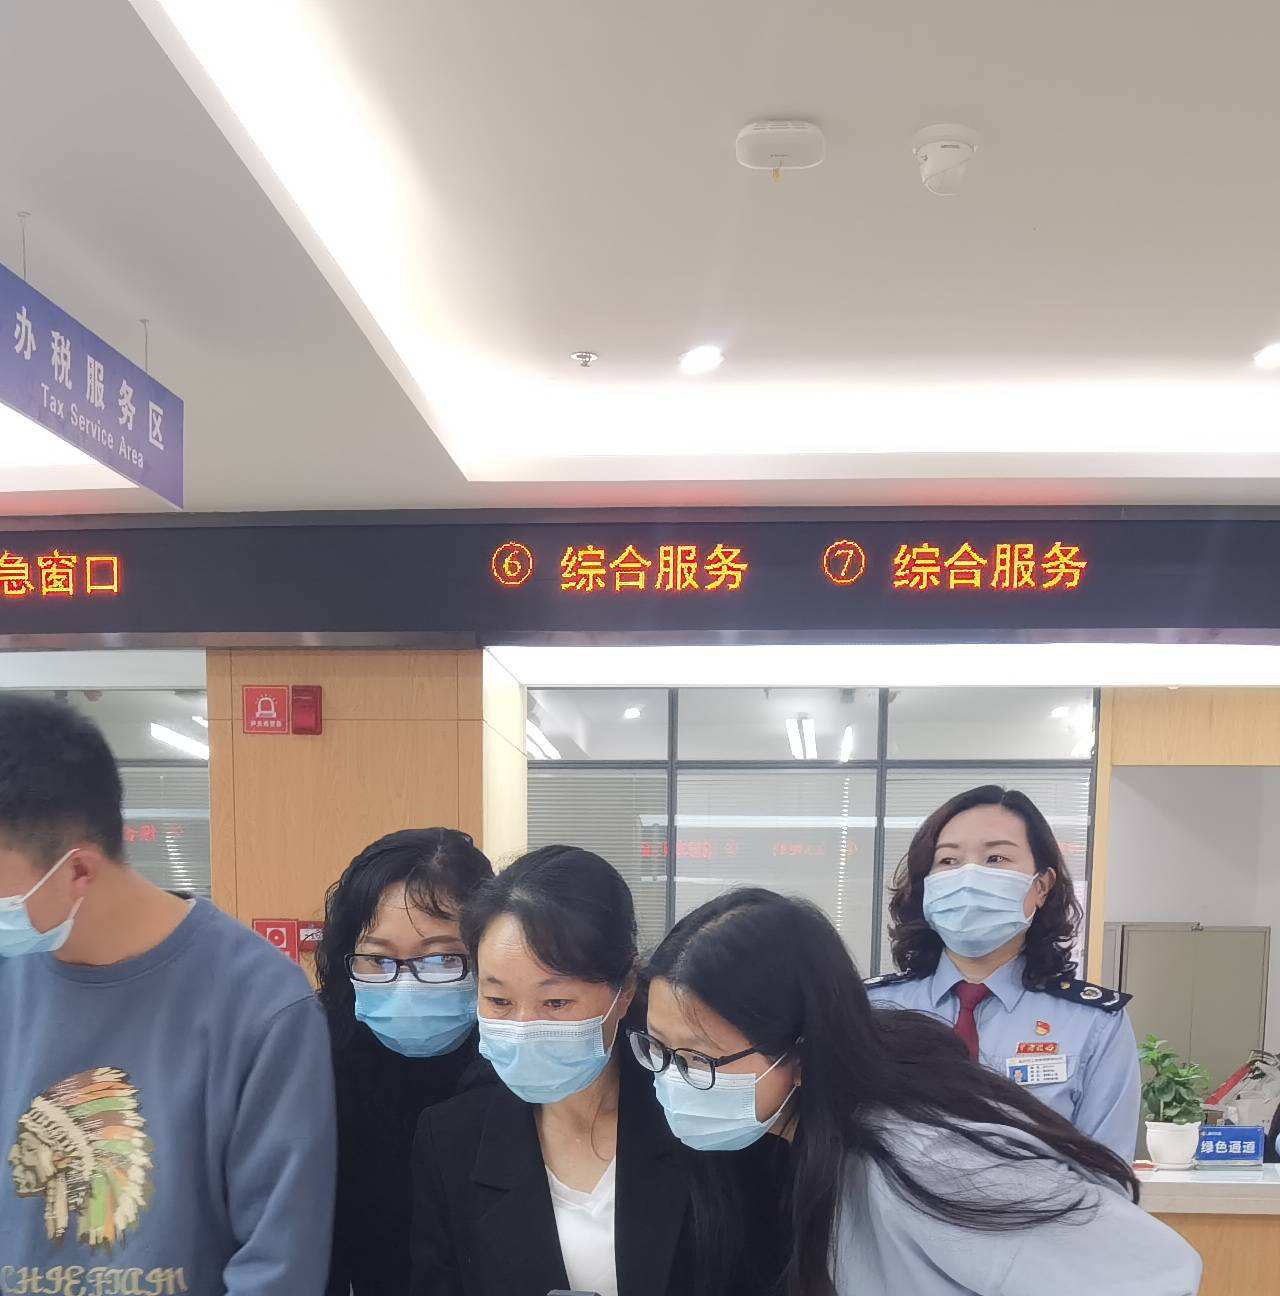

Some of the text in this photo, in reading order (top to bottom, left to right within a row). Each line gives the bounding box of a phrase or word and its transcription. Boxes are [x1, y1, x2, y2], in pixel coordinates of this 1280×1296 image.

[14, 305, 164, 450] 办税服务区
[41, 383, 144, 469] Tax Service Area
[560, 544, 749, 592] 综合服务
[893, 542, 1087, 592] 综合服务
[1200, 1140, 1256, 1154] 绿色通道
